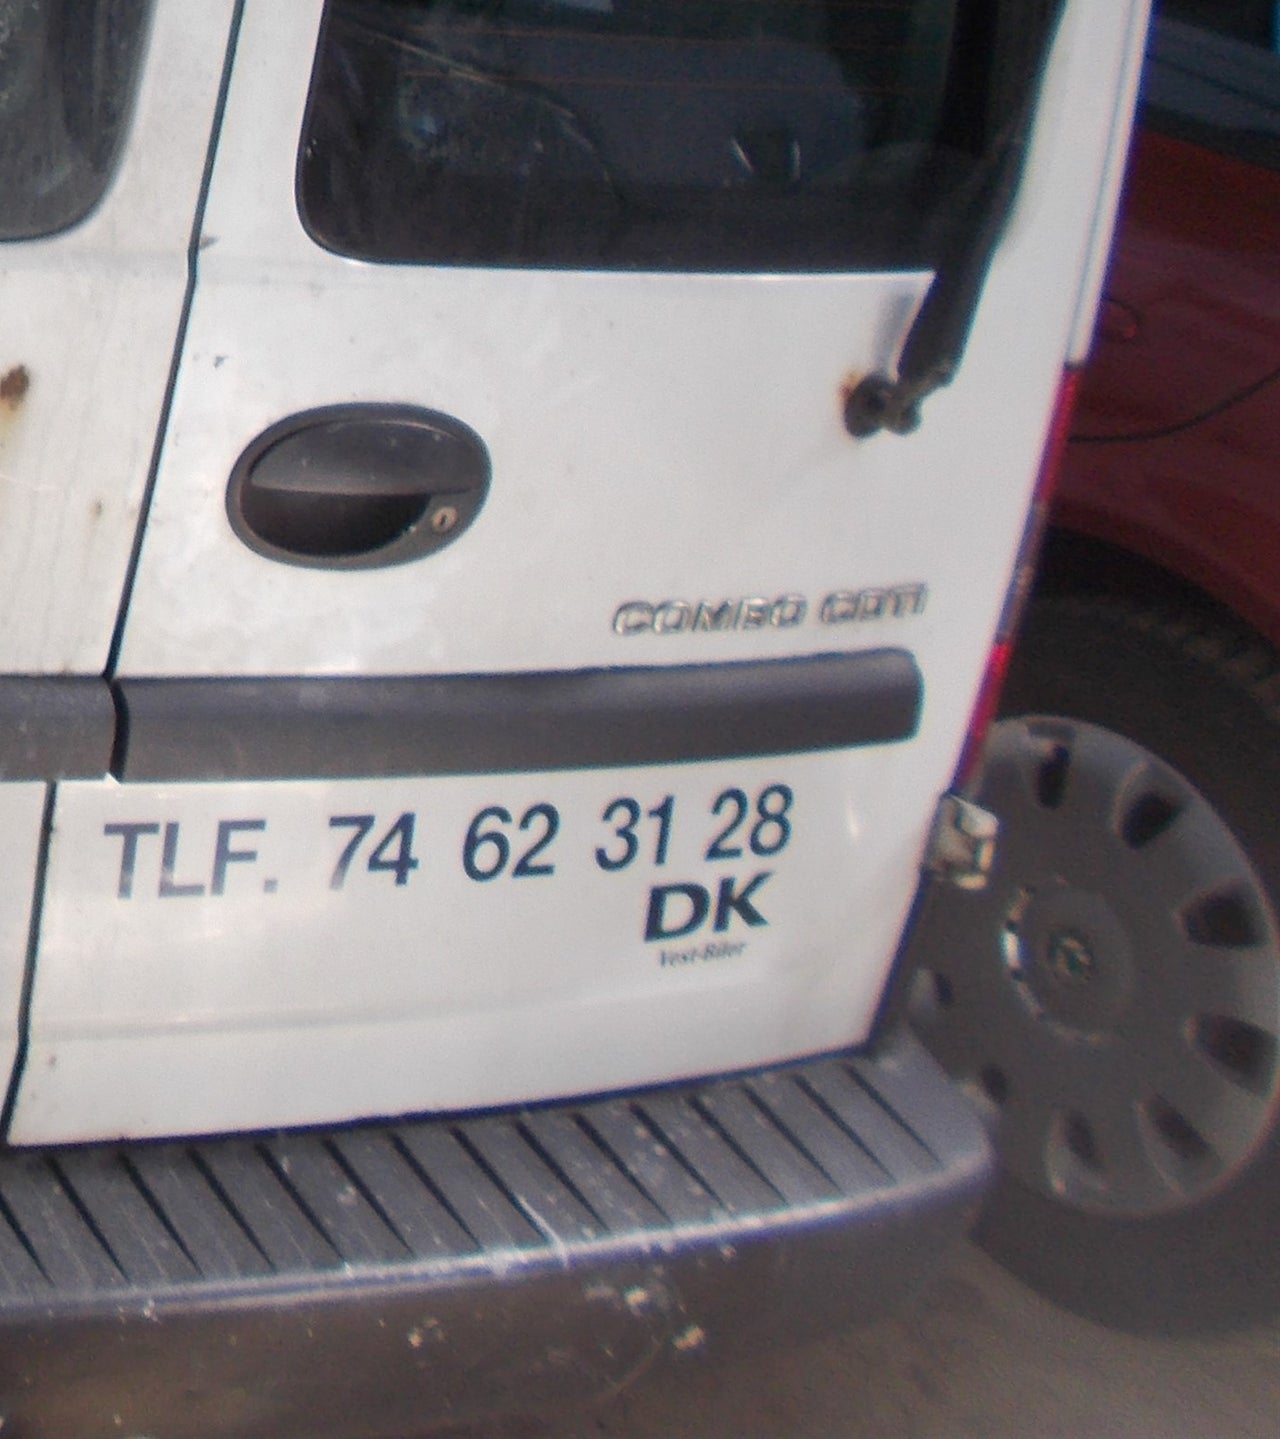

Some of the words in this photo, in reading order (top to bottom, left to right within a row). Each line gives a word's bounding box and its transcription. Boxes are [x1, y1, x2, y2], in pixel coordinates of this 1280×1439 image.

[612, 591, 809, 636] COMBO
[104, 818, 278, 900] TLF.
[328, 812, 420, 890] 74
[461, 802, 561, 883] 62
[594, 795, 676, 872] 31
[705, 784, 795, 861] 28
[644, 871, 775, 942] DK
